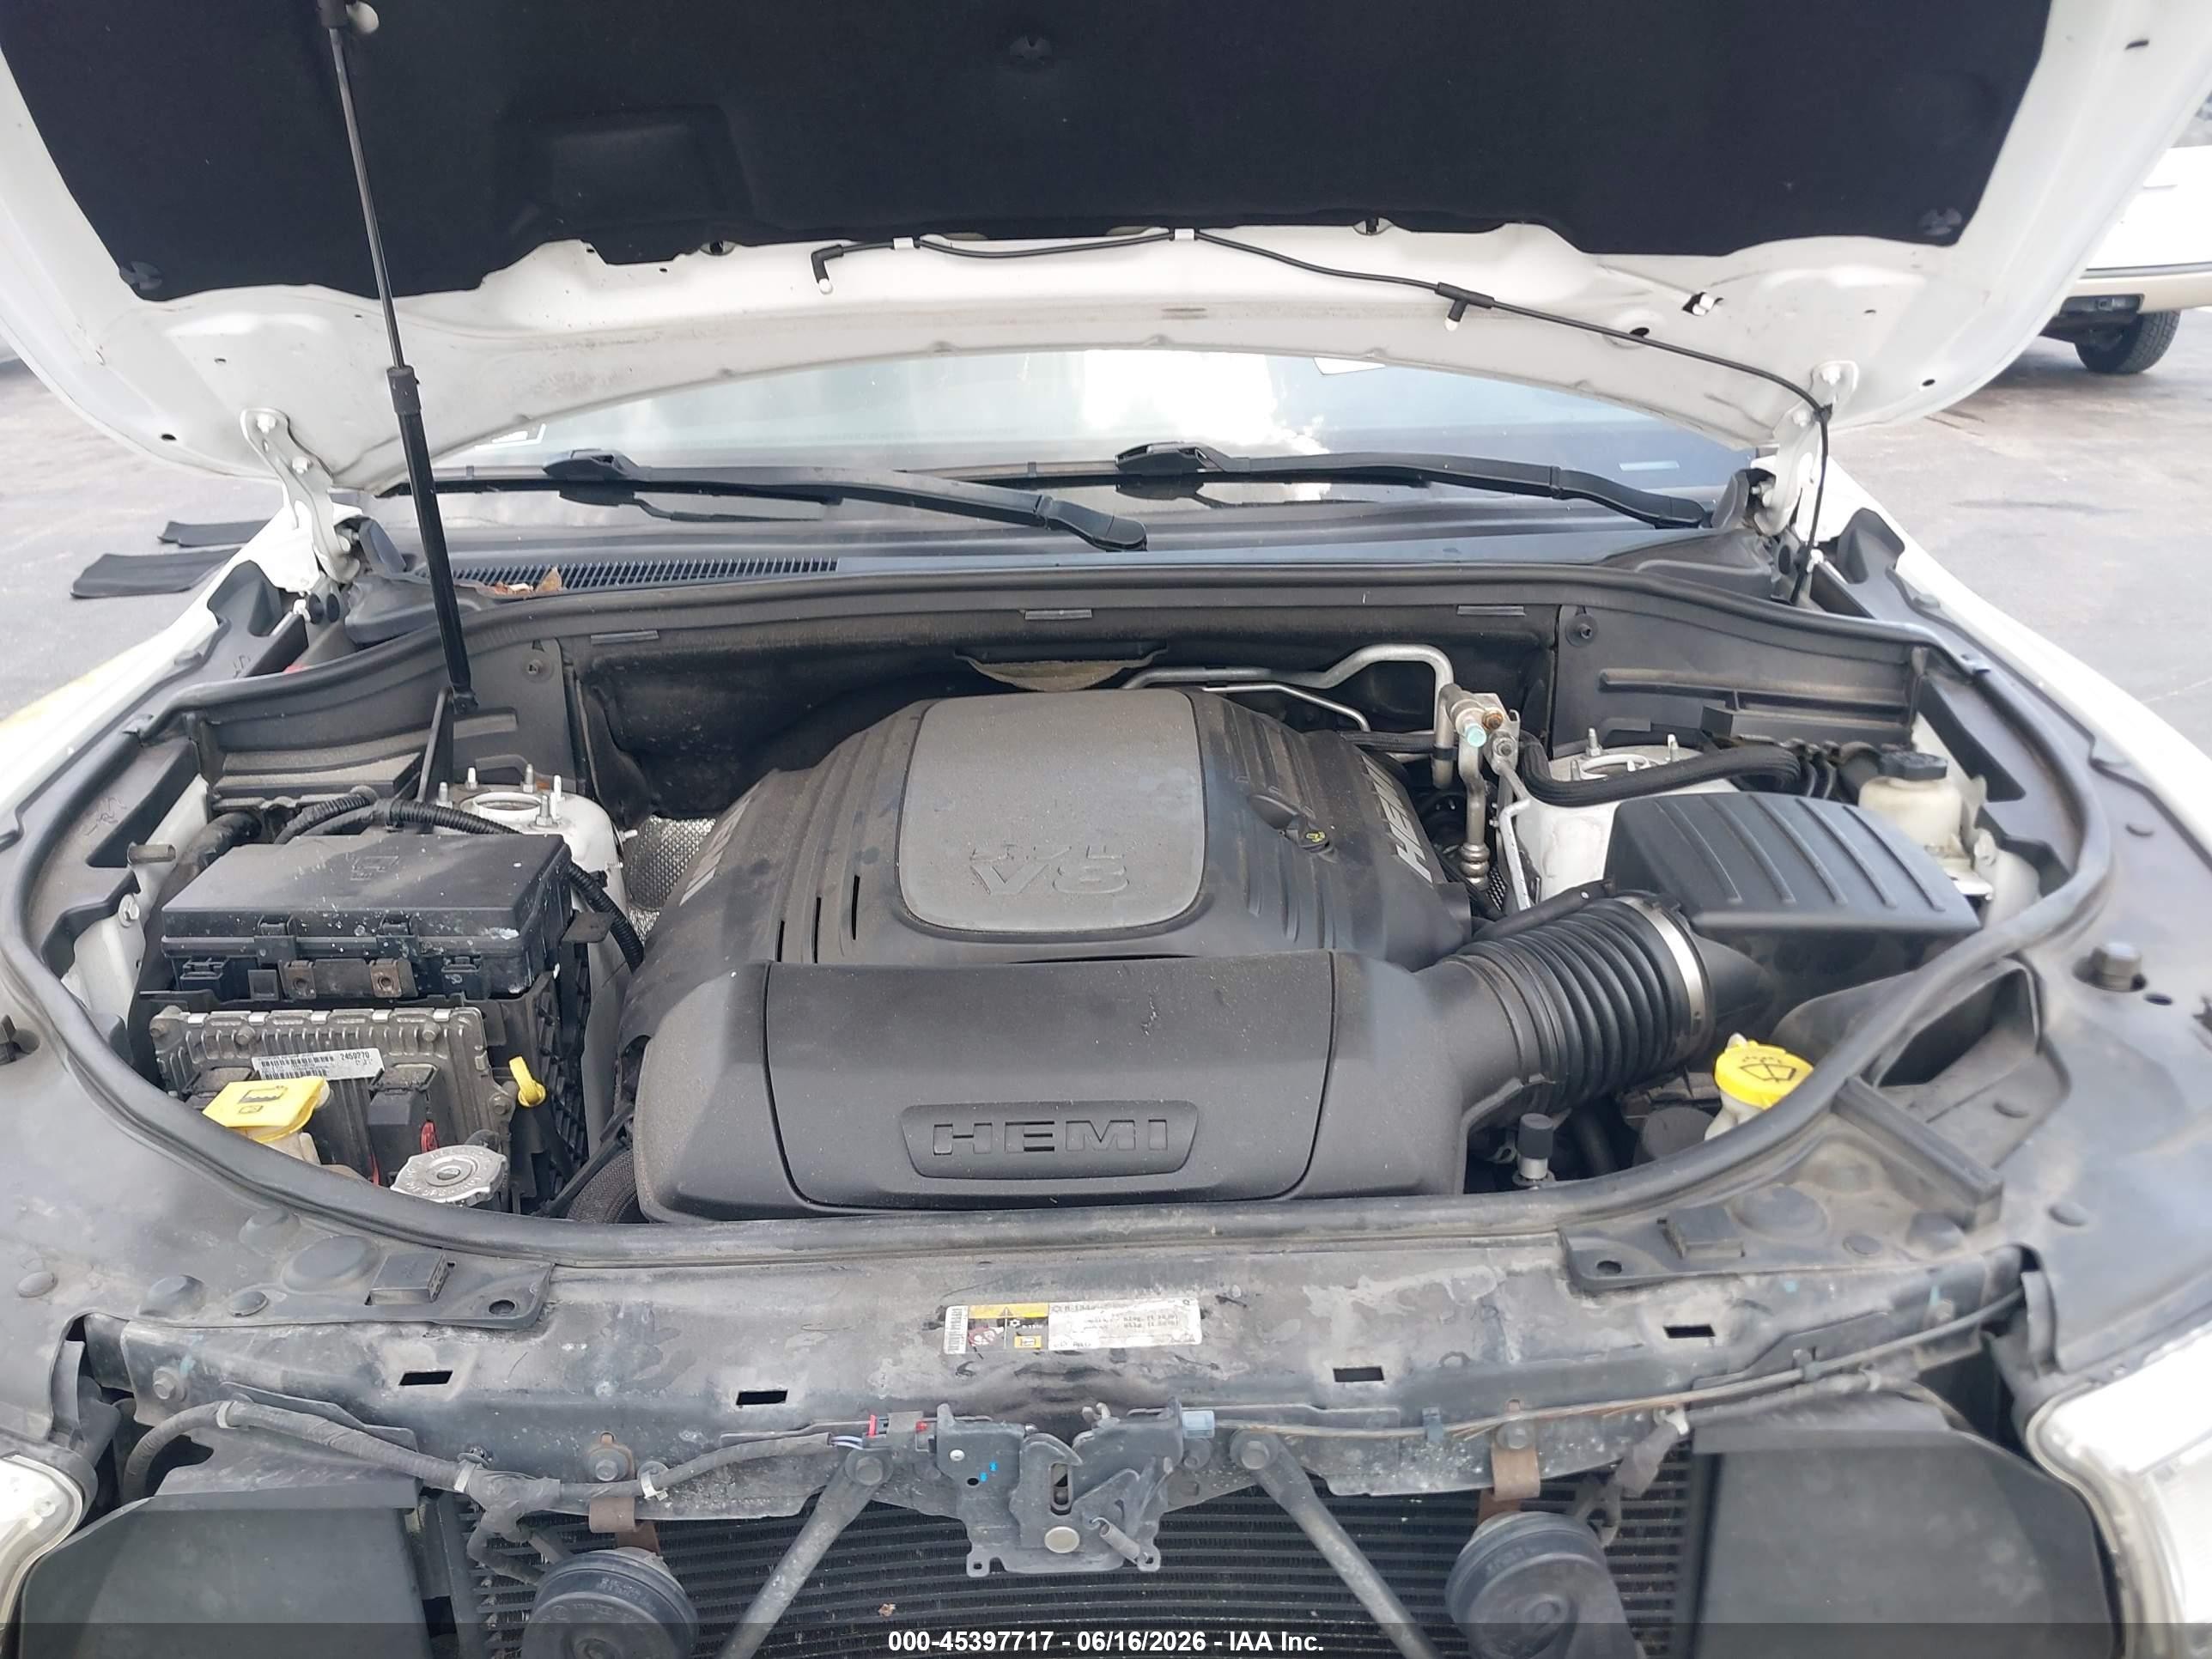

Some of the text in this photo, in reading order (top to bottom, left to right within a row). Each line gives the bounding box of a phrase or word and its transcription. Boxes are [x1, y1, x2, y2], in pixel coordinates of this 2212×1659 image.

[1361, 755, 1433, 884] HEMI
[969, 863, 1130, 896] V8
[933, 1118, 1169, 1156] HEMI
